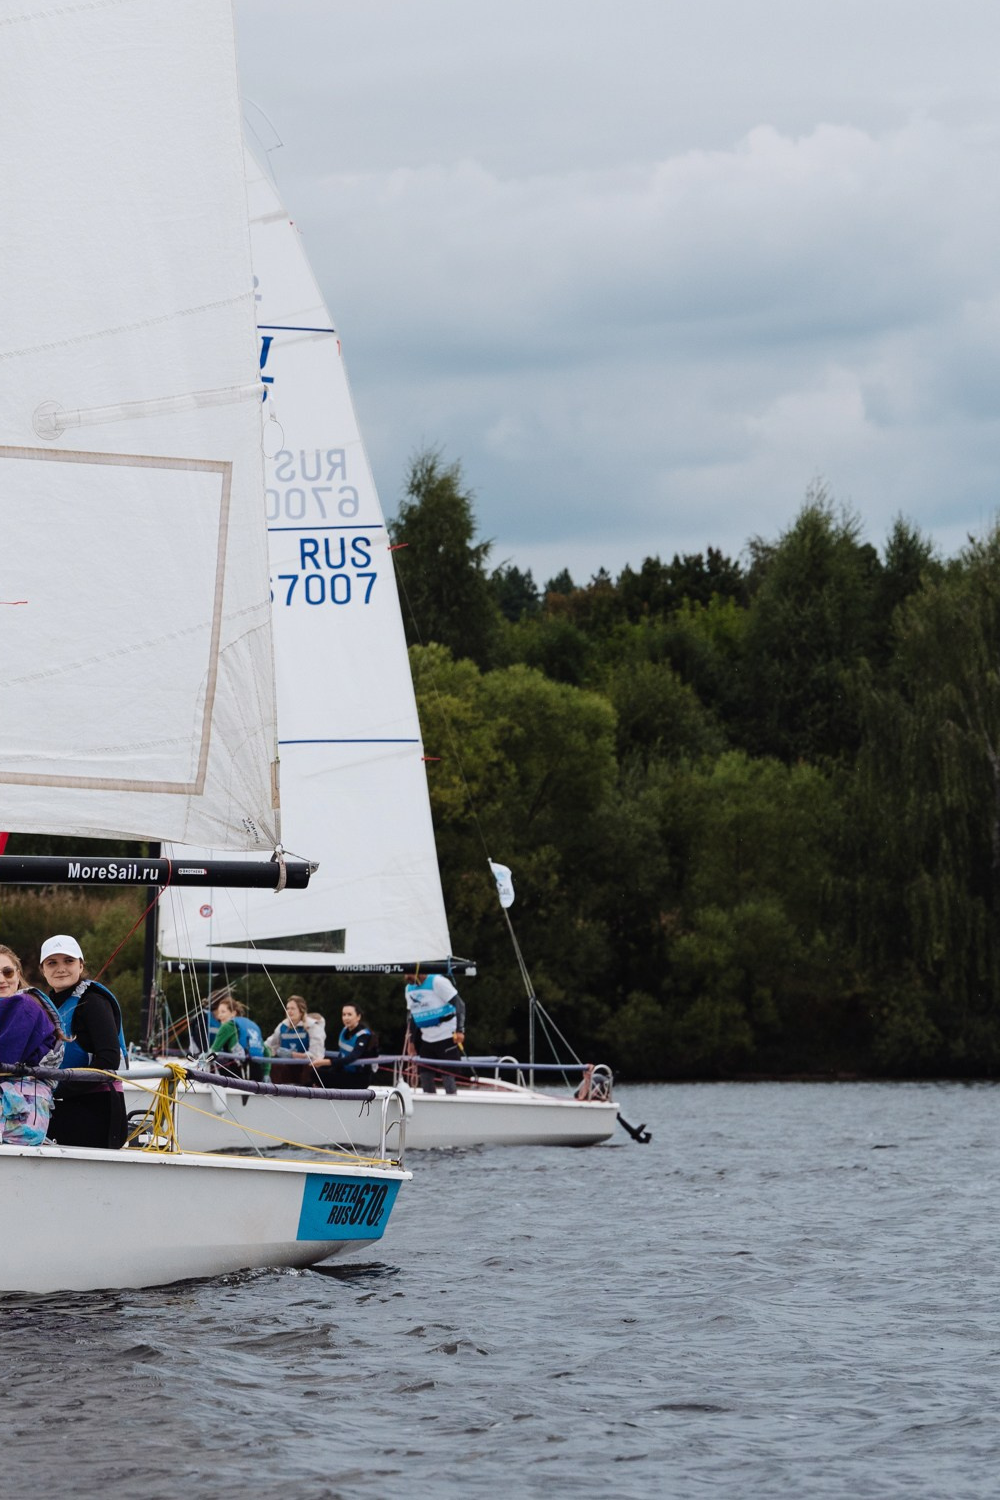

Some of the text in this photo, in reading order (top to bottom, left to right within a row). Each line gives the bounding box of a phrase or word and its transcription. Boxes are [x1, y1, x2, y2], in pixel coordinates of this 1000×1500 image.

[299, 536, 372, 570] RUS
[269, 572, 378, 606] 7007
[67, 862, 159, 881] MoreSail.ru
[326, 1204, 353, 1226] RUS
